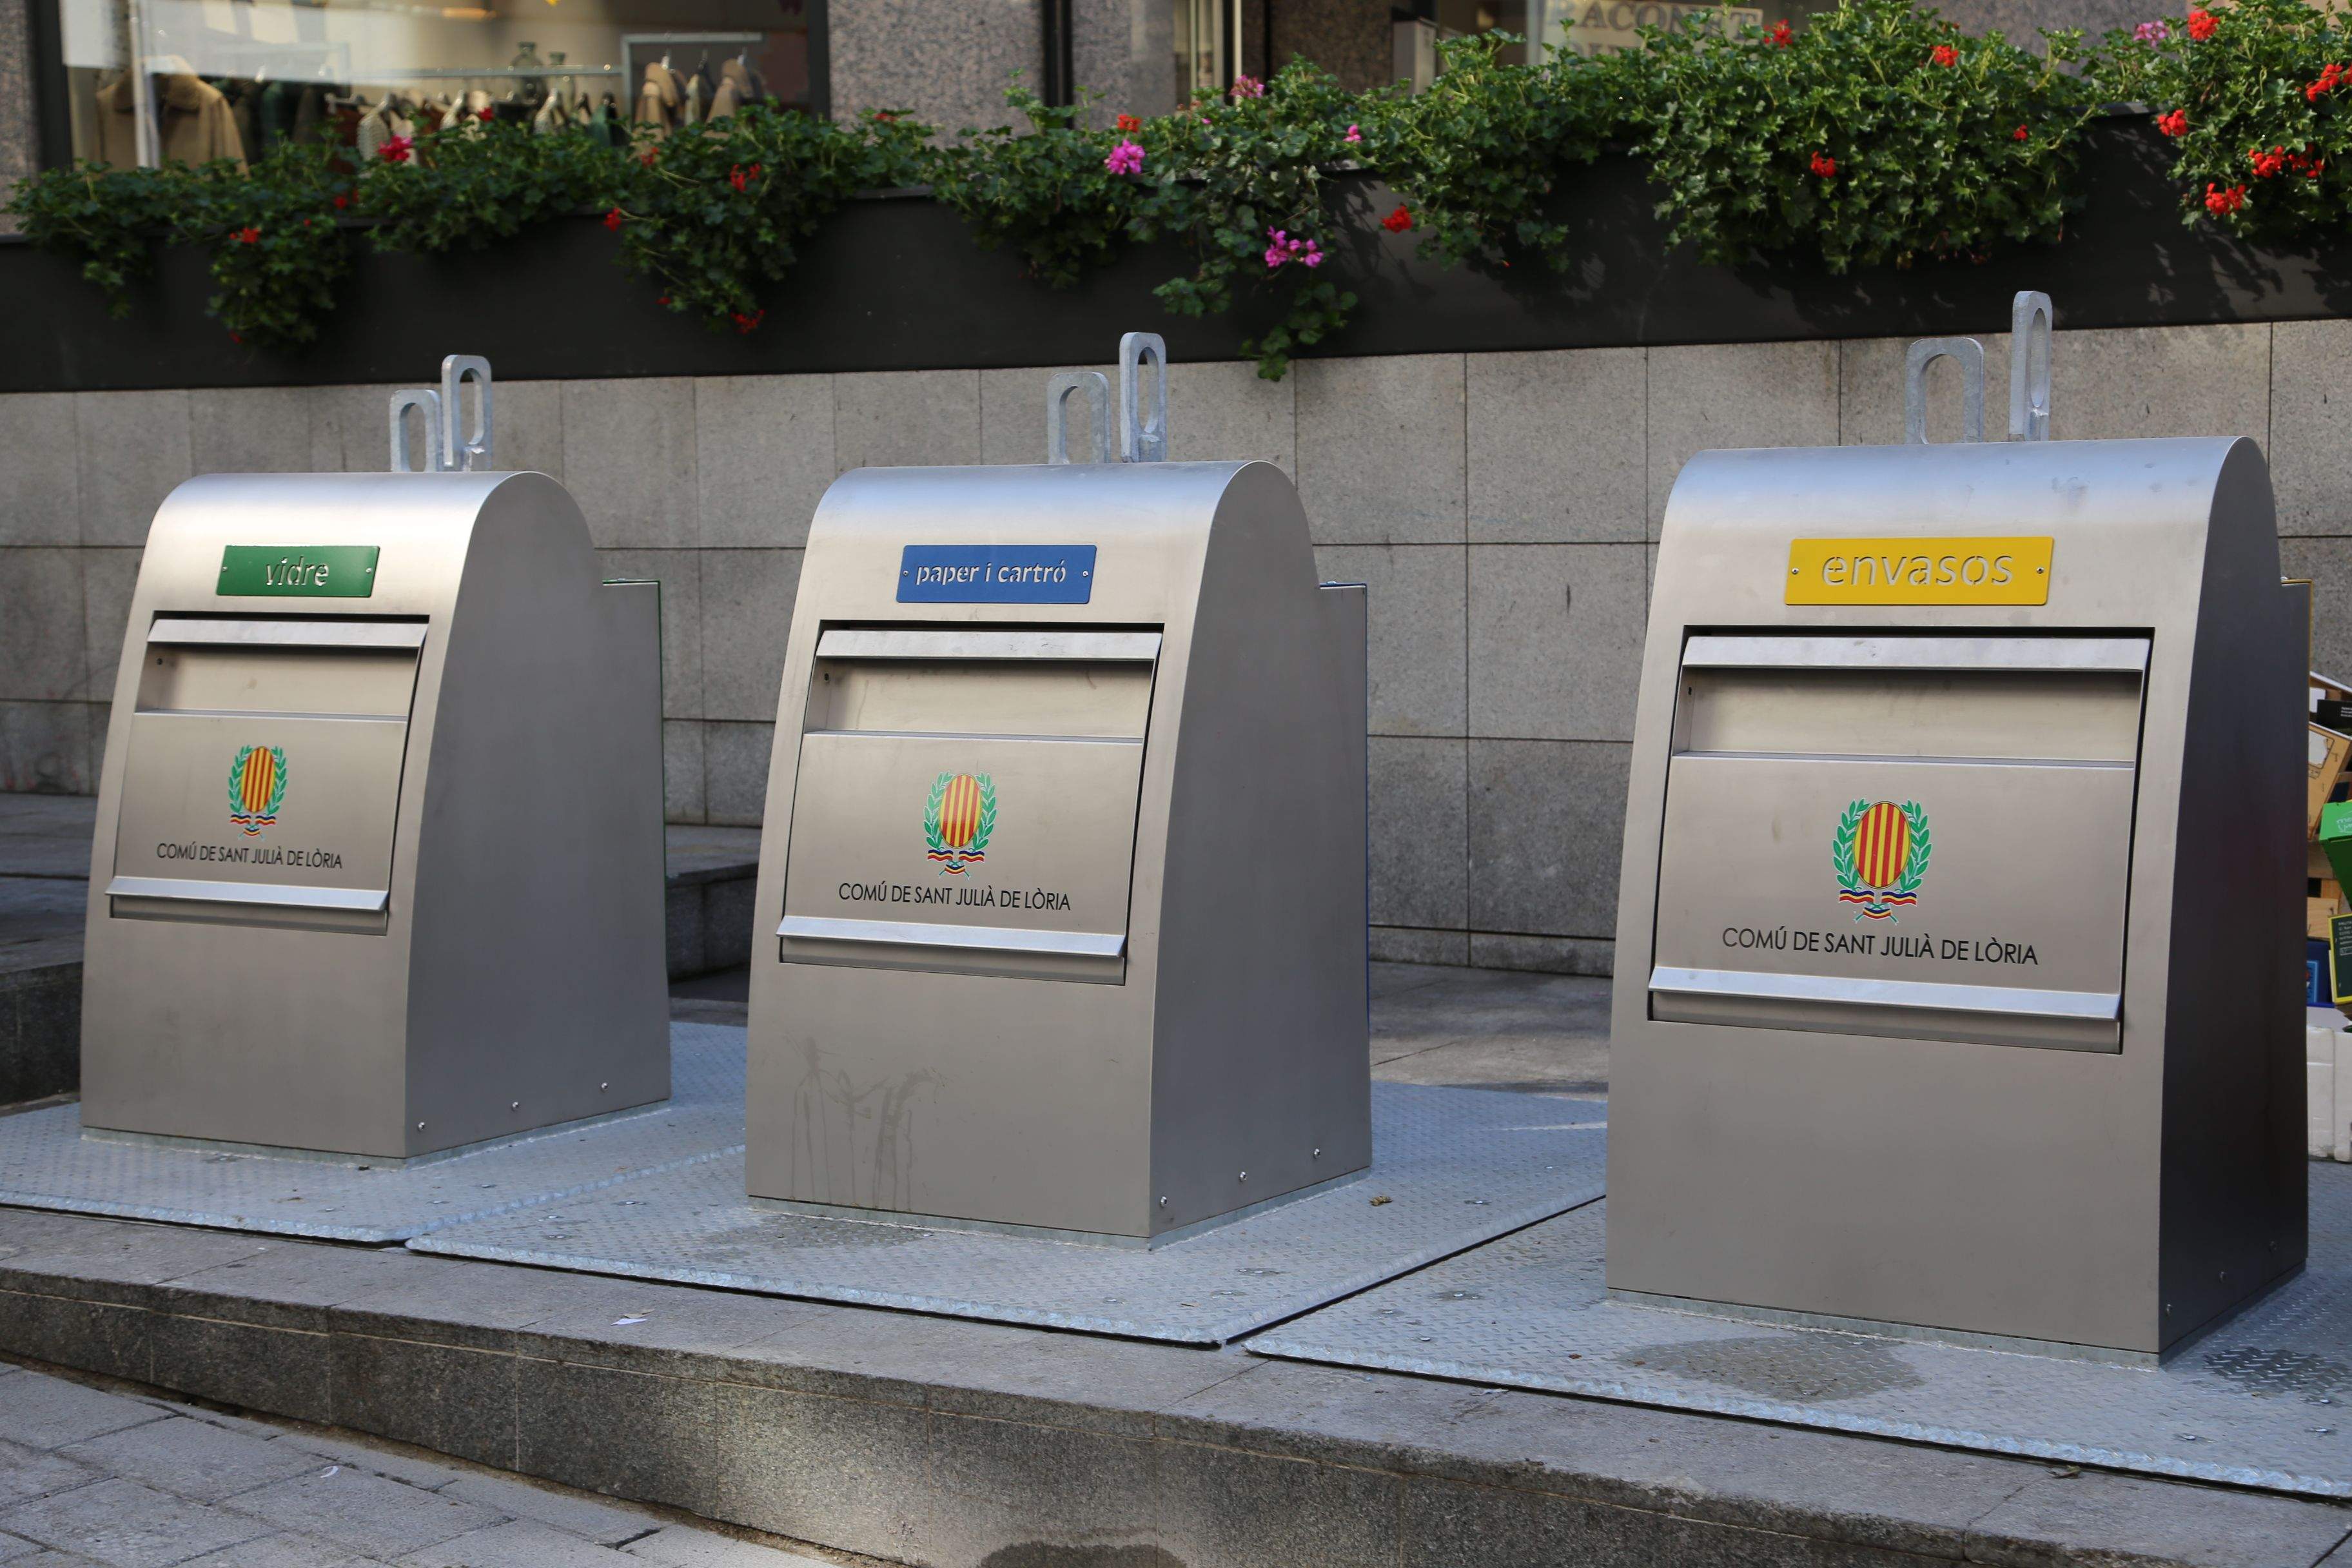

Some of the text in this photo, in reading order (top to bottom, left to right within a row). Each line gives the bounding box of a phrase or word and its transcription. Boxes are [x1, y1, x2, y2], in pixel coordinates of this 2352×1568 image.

[265, 555, 329, 586] vidre
[915, 560, 1066, 585] paper i cartró
[1821, 555, 2014, 586] envasos
[156, 841, 342, 868] COMÚ DE SANT JULIÀ DE LÒRIA
[839, 881, 1071, 911] COMÚ DE SANT JULIÀ DE LÒRIA
[1722, 926, 2039, 966] COMÚ DE SANT JULIÀ DE LÒRIA
